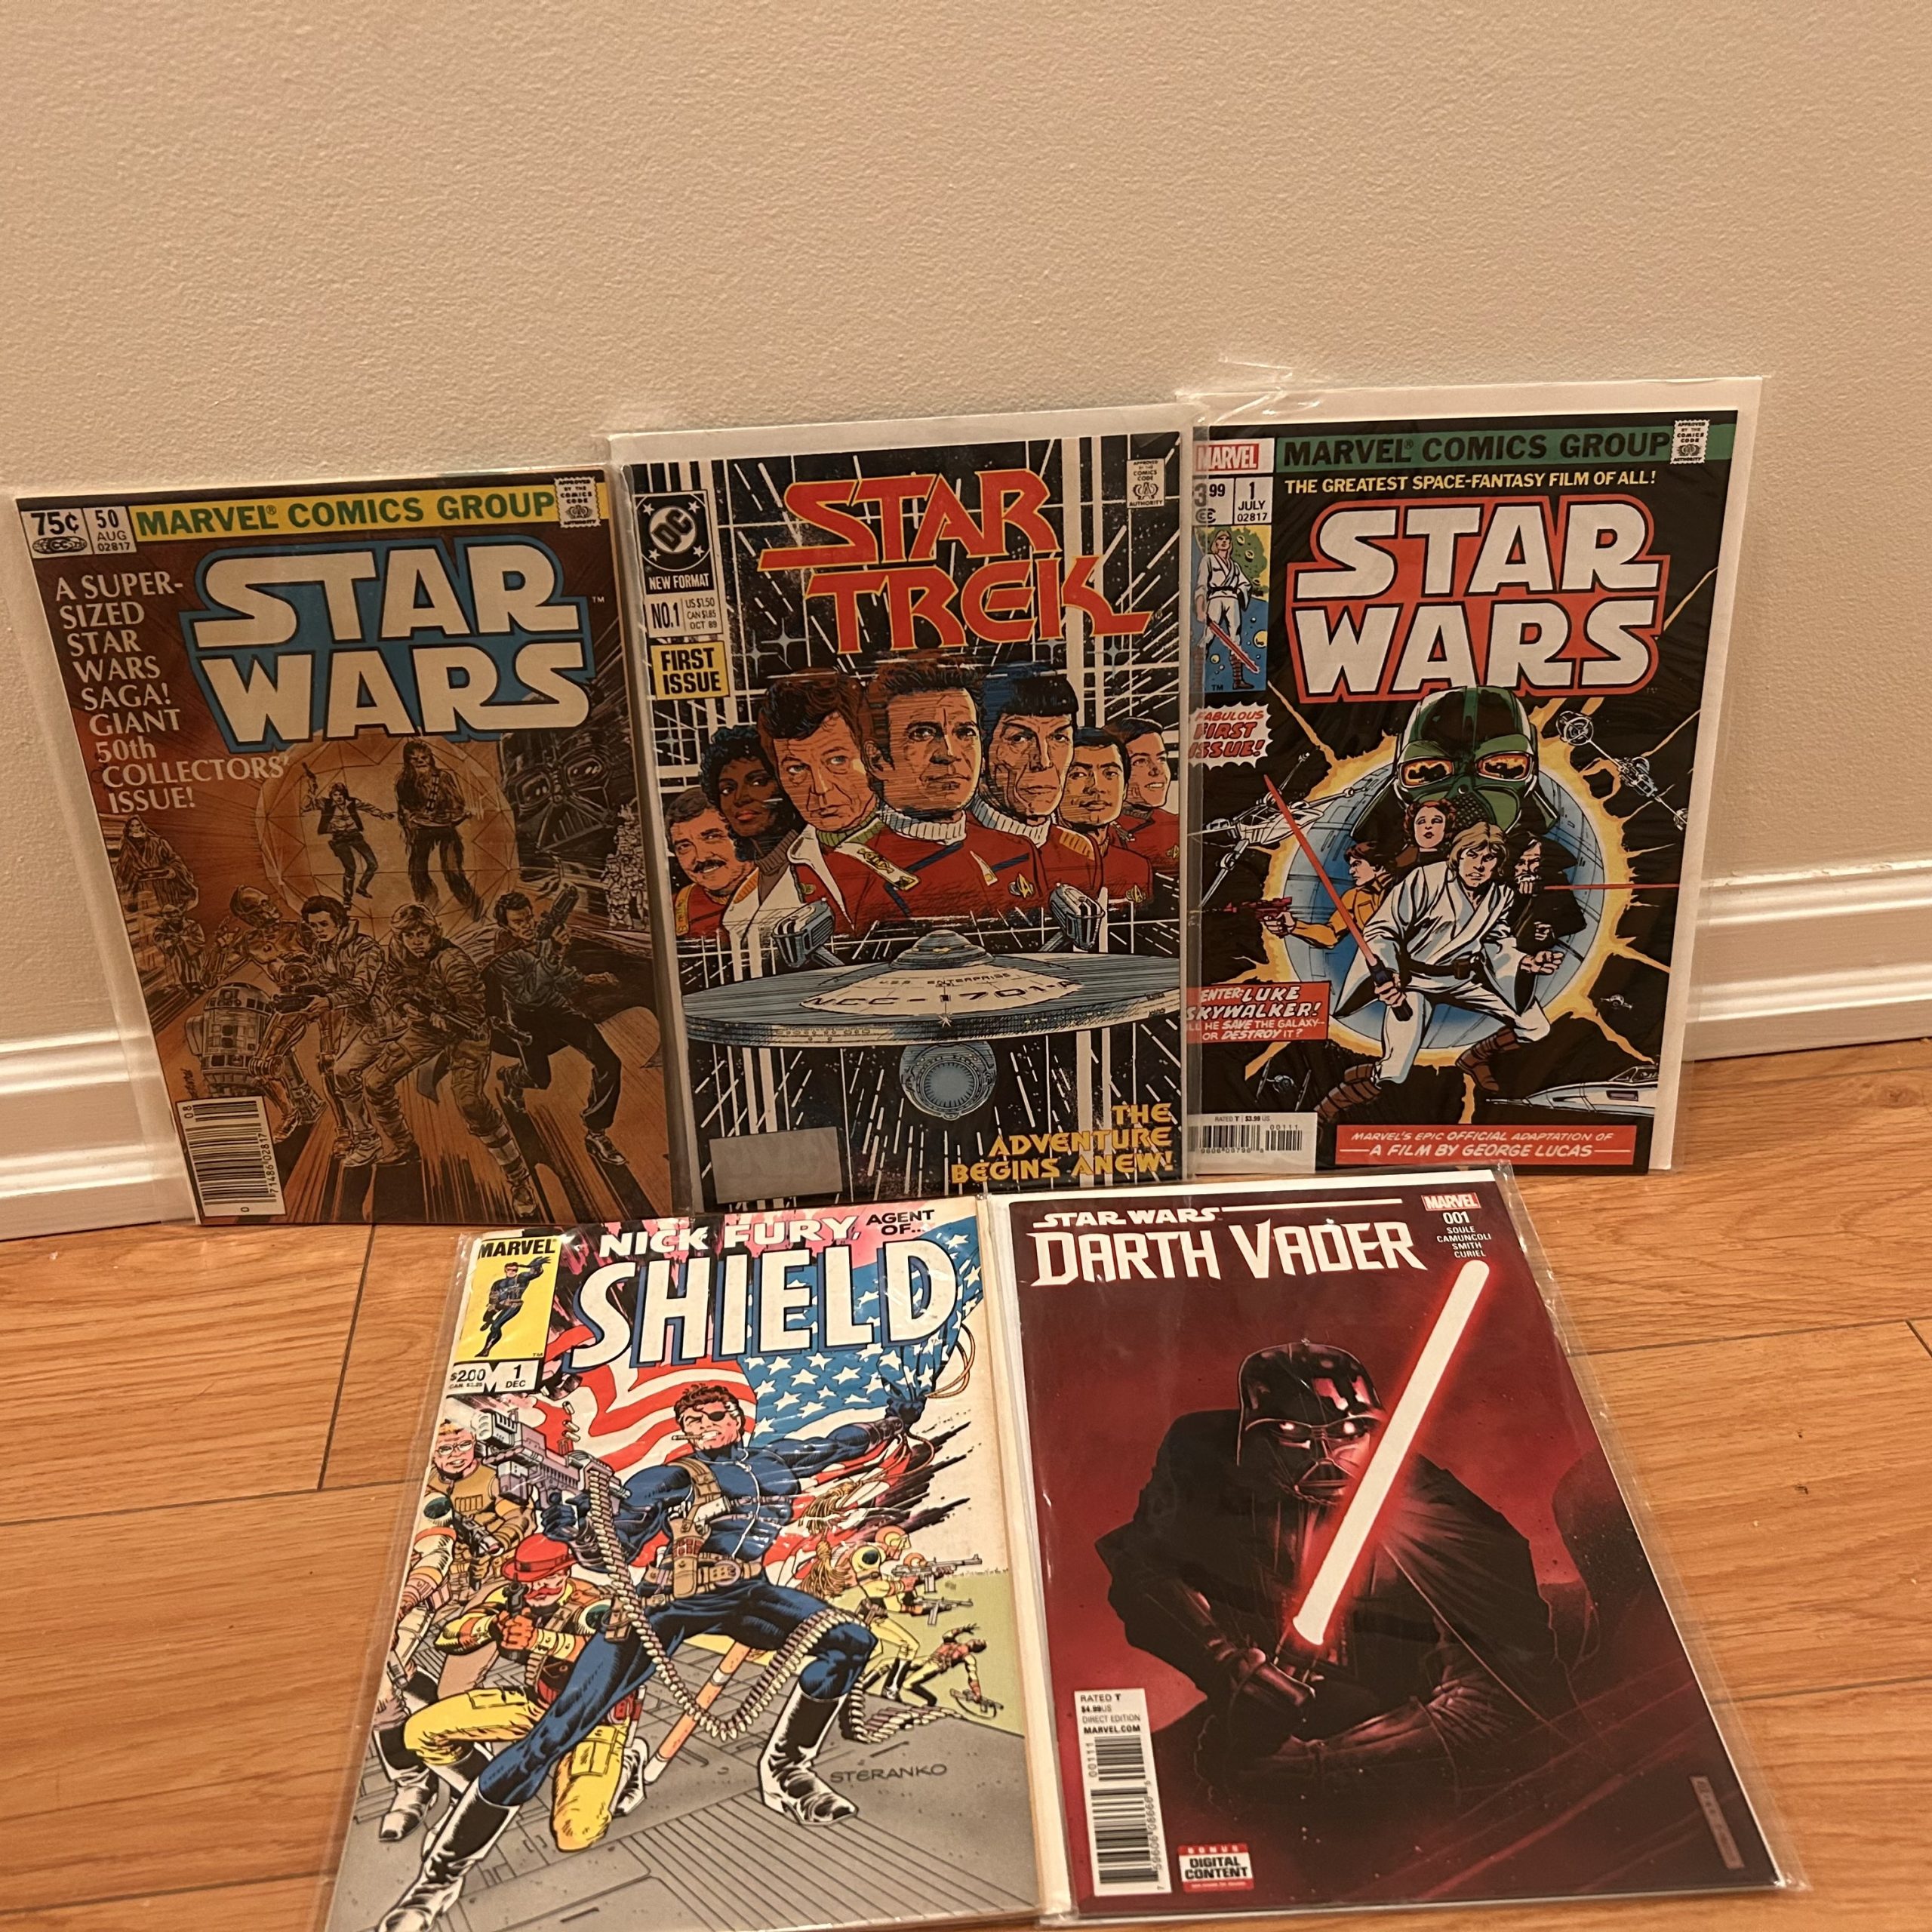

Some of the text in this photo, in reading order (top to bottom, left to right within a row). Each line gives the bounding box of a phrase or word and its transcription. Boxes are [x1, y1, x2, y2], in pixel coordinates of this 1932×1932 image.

[1423, 435, 1546, 462] COMICS
[1560, 432, 1669, 459] GROUP
[1197, 445, 1258, 469] MARVEL
[1249, 481, 1255, 500] 1
[1285, 470, 1657, 494] THE GREATEST SPACE-FANTASY FILM OF ALL!
[288, 497, 423, 528] COMICS
[437, 492, 554, 521] GROUP
[1238, 500, 1266, 511] JULY
[31, 512, 79, 535] 75¢
[95, 509, 118, 528] 50
[757, 468, 1062, 571] STAR
[1238, 512, 1268, 522] 02817
[97, 531, 127, 541] AUG
[650, 506, 694, 552] DC
[97, 542, 131, 552] 02817
[1294, 502, 1660, 601] STAR
[56, 571, 183, 601] A SUPER-
[648, 573, 709, 590] NEW FORMAT
[190, 543, 583, 650] STAR
[685, 599, 696, 608] US
[804, 555, 1155, 654] TREK
[60, 601, 145, 629] SIZED
[687, 611, 700, 620] CAN
[690, 621, 706, 630] OCT
[67, 629, 142, 657] STAR
[1292, 598, 1657, 694] WARS
[660, 648, 715, 671] FIRST
[72, 656, 161, 683] WARS
[198, 640, 591, 743] WARS
[663, 671, 721, 695] ISSUE
[82, 682, 171, 711] SAGA!
[89, 709, 180, 737] GIANT
[1195, 711, 1265, 721] FABULOUS
[1193, 721, 1258, 740] FIRST
[95, 736, 156, 763] 50th
[1188, 740, 1266, 758] ISSUE!
[102, 755, 289, 788] COLLECTORS'
[109, 786, 195, 814] ISSUE!
[928, 973, 1010, 985] ENTERPRISE
[1242, 986, 1300, 1003] LUKE
[1186, 1002, 1321, 1021] SKYWALKER!
[1202, 1032, 1218, 1041] OR
[1220, 1029, 1281, 1040] DESTROY
[1204, 1021, 1220, 1031] HE
[1222, 1020, 1254, 1030] SAVE
[1255, 1020, 1275, 1029] THE
[1112, 1103, 1172, 1124] THE
[989, 1126, 1172, 1157] ADVENTURE
[1351, 1131, 1614, 1141] MARVEL'S EPIC OFFICIAL ADAPTATION OF
[1369, 1143, 1594, 1157] A FILM BY GEORGE LUCAS
[952, 1151, 1173, 1184] BEGINS ANEW!
[1423, 1194, 1479, 1210] MARVEL
[866, 1209, 935, 1226] AGENT
[1033, 1207, 1220, 1229] STAR WARS
[1443, 1211, 1469, 1224] 001
[599, 1216, 860, 1257] NICK FURY,
[1437, 1233, 1492, 1242] CAMUNCOLI
[1447, 1226, 1475, 1234] SOULE
[478, 1238, 555, 1260] MARVEL
[1027, 1218, 1428, 1287] DARTH VADER
[1452, 1241, 1482, 1251] SMITH
[1454, 1250, 1486, 1258] CURIEL
[568, 1238, 958, 1371] SHIELD
[514, 1364, 521, 1379] 1
[506, 1380, 526, 1388] DEC
[1081, 1694, 1112, 1703] RATED
[1082, 1714, 1140, 1723] DIRECT EDITION
[1084, 1724, 1140, 1734] MARVEL.COM
[830, 1764, 947, 1783] STERANKO
[1189, 1857, 1241, 1868] DIGITAL
[1185, 1866, 1247, 1879] CONTENT
